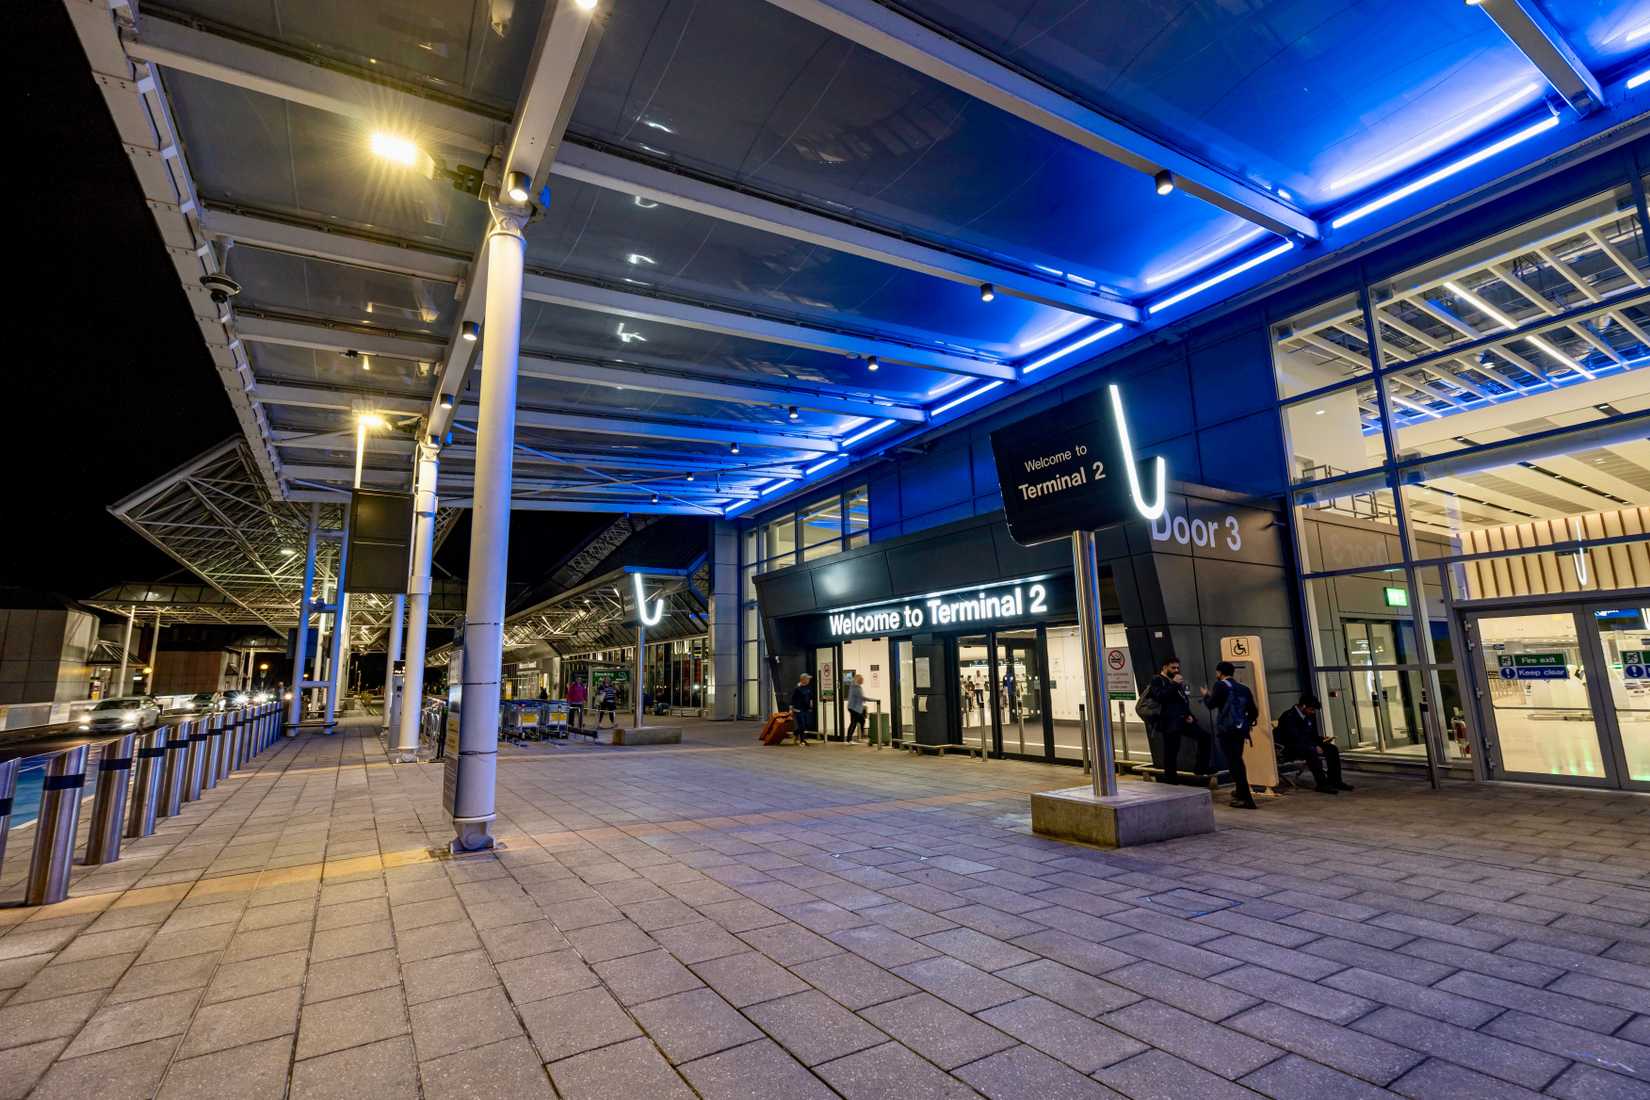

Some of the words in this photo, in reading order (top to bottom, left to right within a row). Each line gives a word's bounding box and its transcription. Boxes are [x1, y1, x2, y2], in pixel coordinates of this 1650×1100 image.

[1024, 449, 1072, 473] Welcome
[1075, 445, 1087, 456] to
[1018, 467, 1087, 500] Terminal
[1092, 461, 1106, 480] 2
[1151, 511, 1219, 549] Door
[1225, 515, 1242, 551] 3
[829, 611, 899, 636] Welcome
[903, 605, 924, 628] to
[926, 588, 1022, 625] Terminal
[1029, 584, 1048, 614] 2
[1519, 669, 1541, 677] Keep
[1543, 668, 1565, 676] clear
